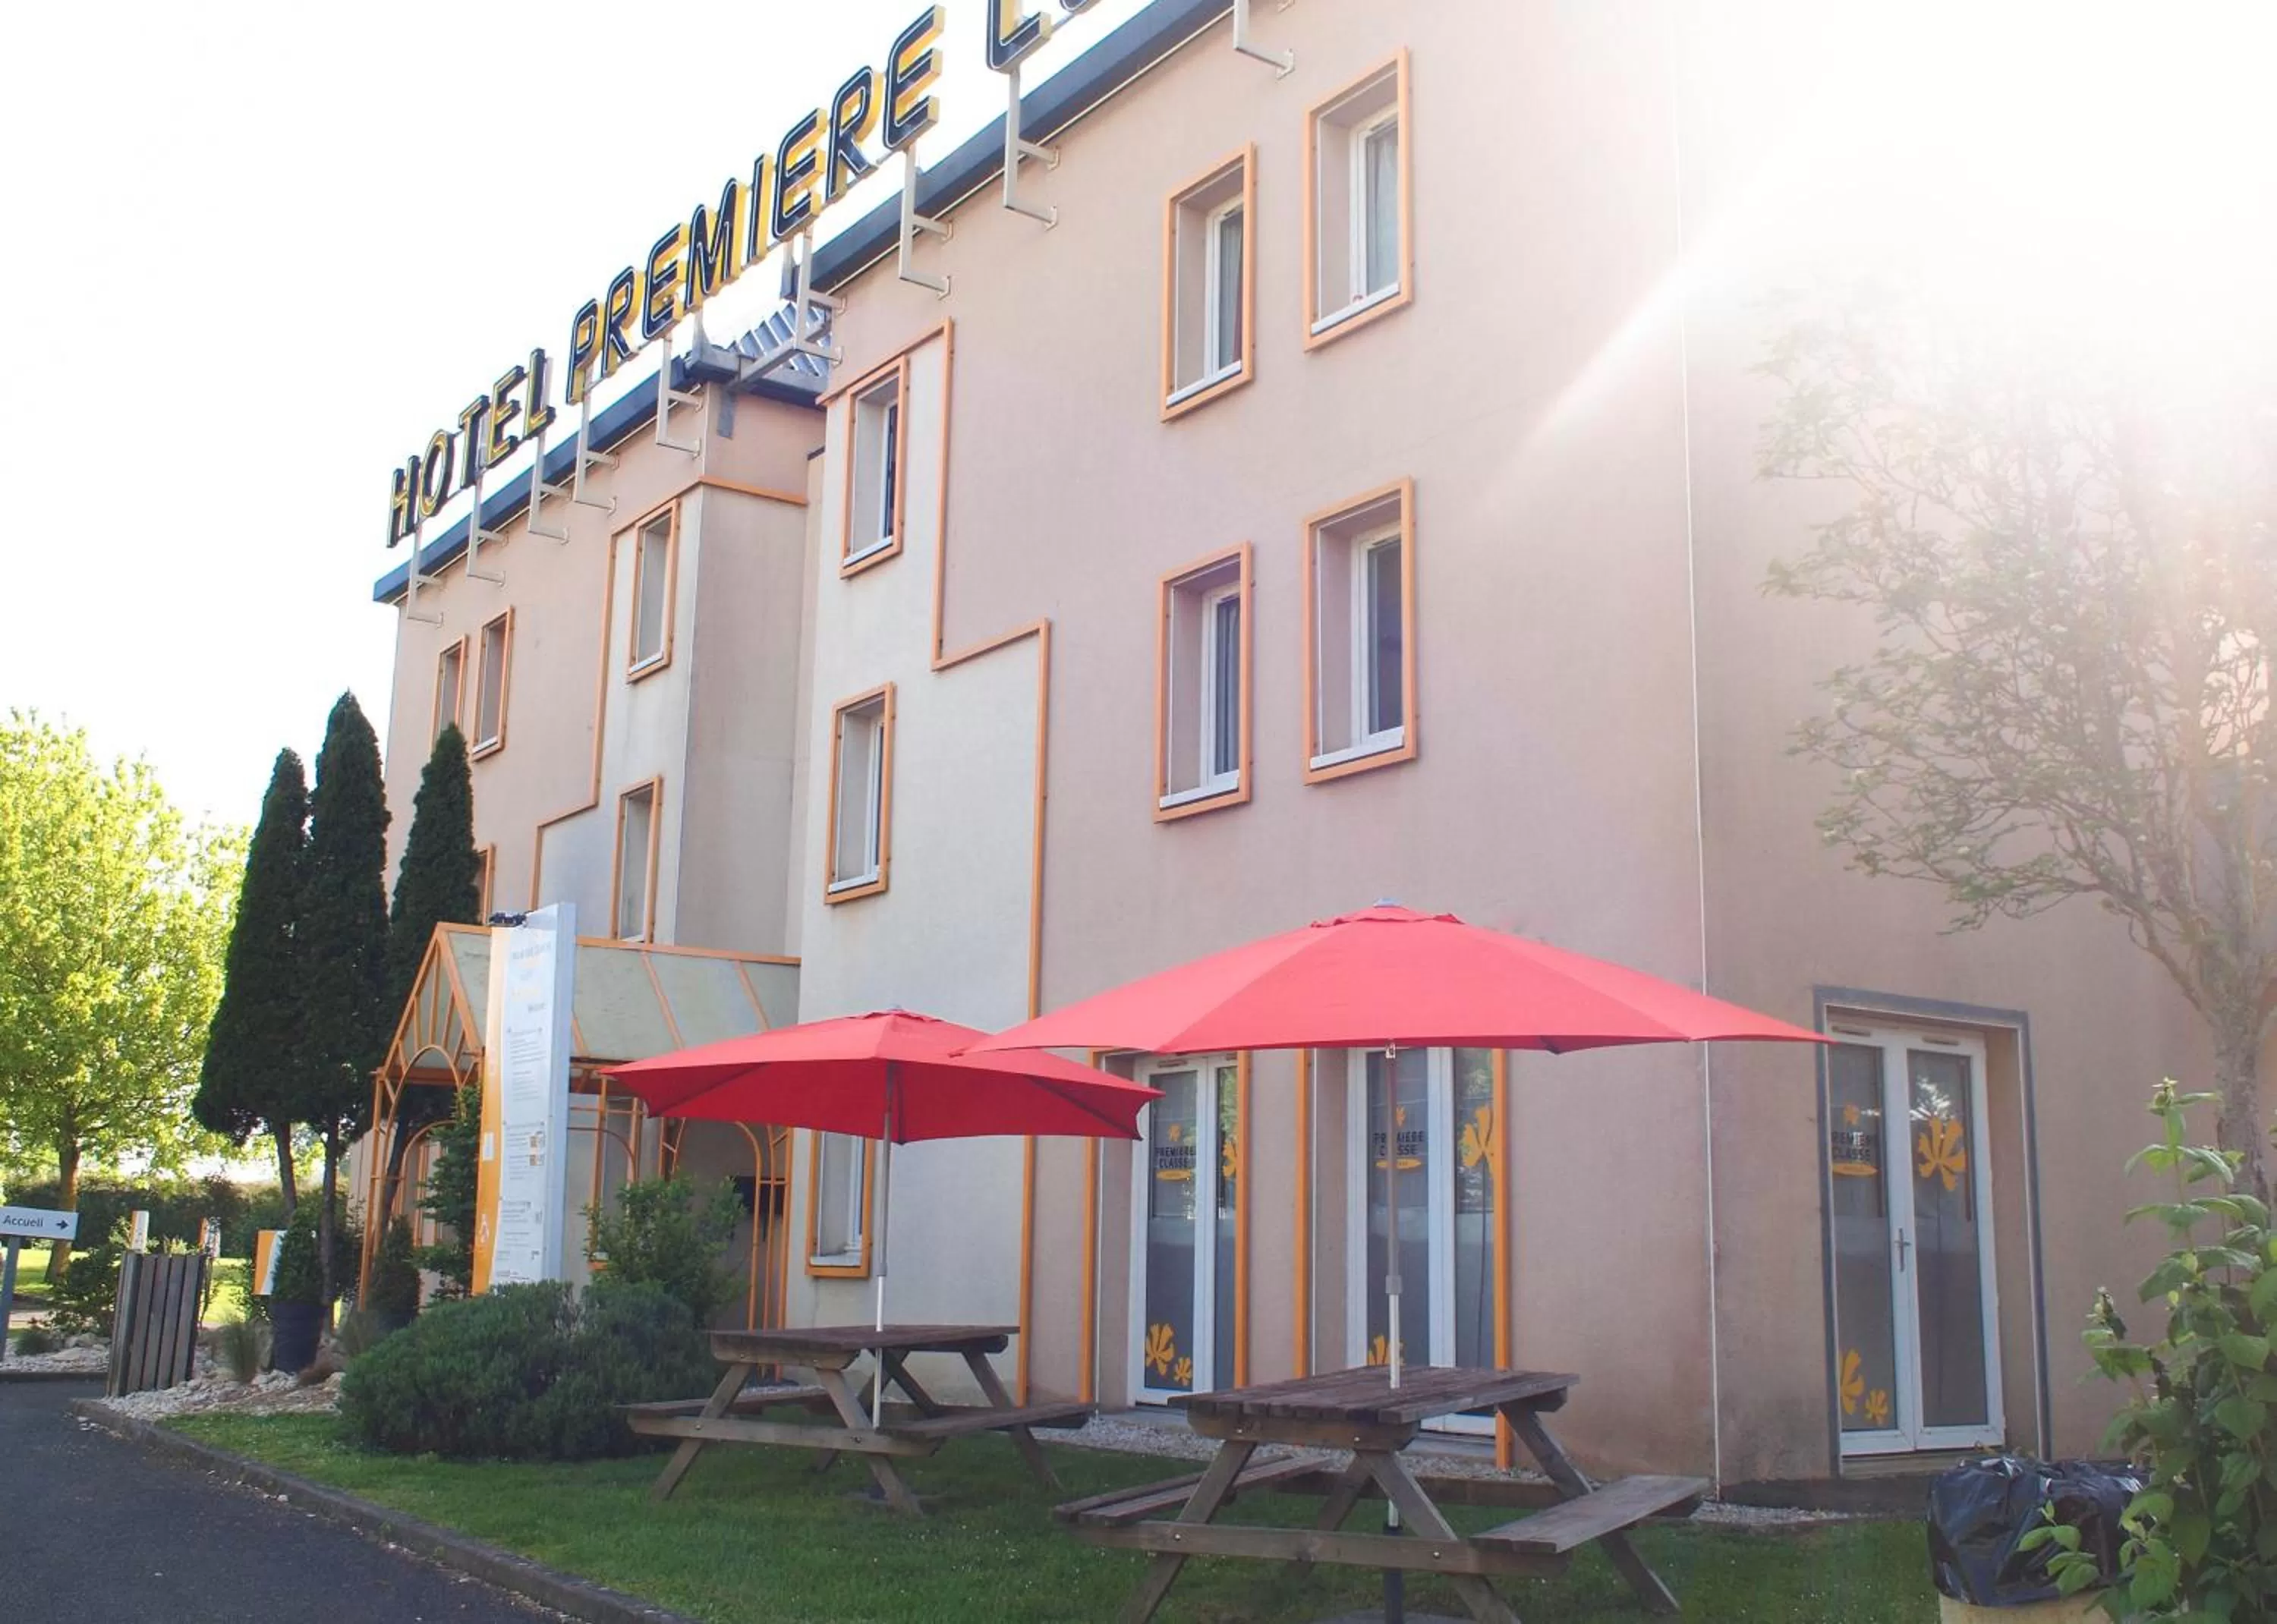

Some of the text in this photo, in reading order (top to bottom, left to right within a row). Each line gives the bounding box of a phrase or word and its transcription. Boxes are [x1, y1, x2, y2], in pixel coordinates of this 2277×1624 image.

[386, 4, 946, 548] HOTEL PREMIERE
[1378, 1144, 1419, 1156] CSSE
[2, 1215, 44, 1227] Accueil
